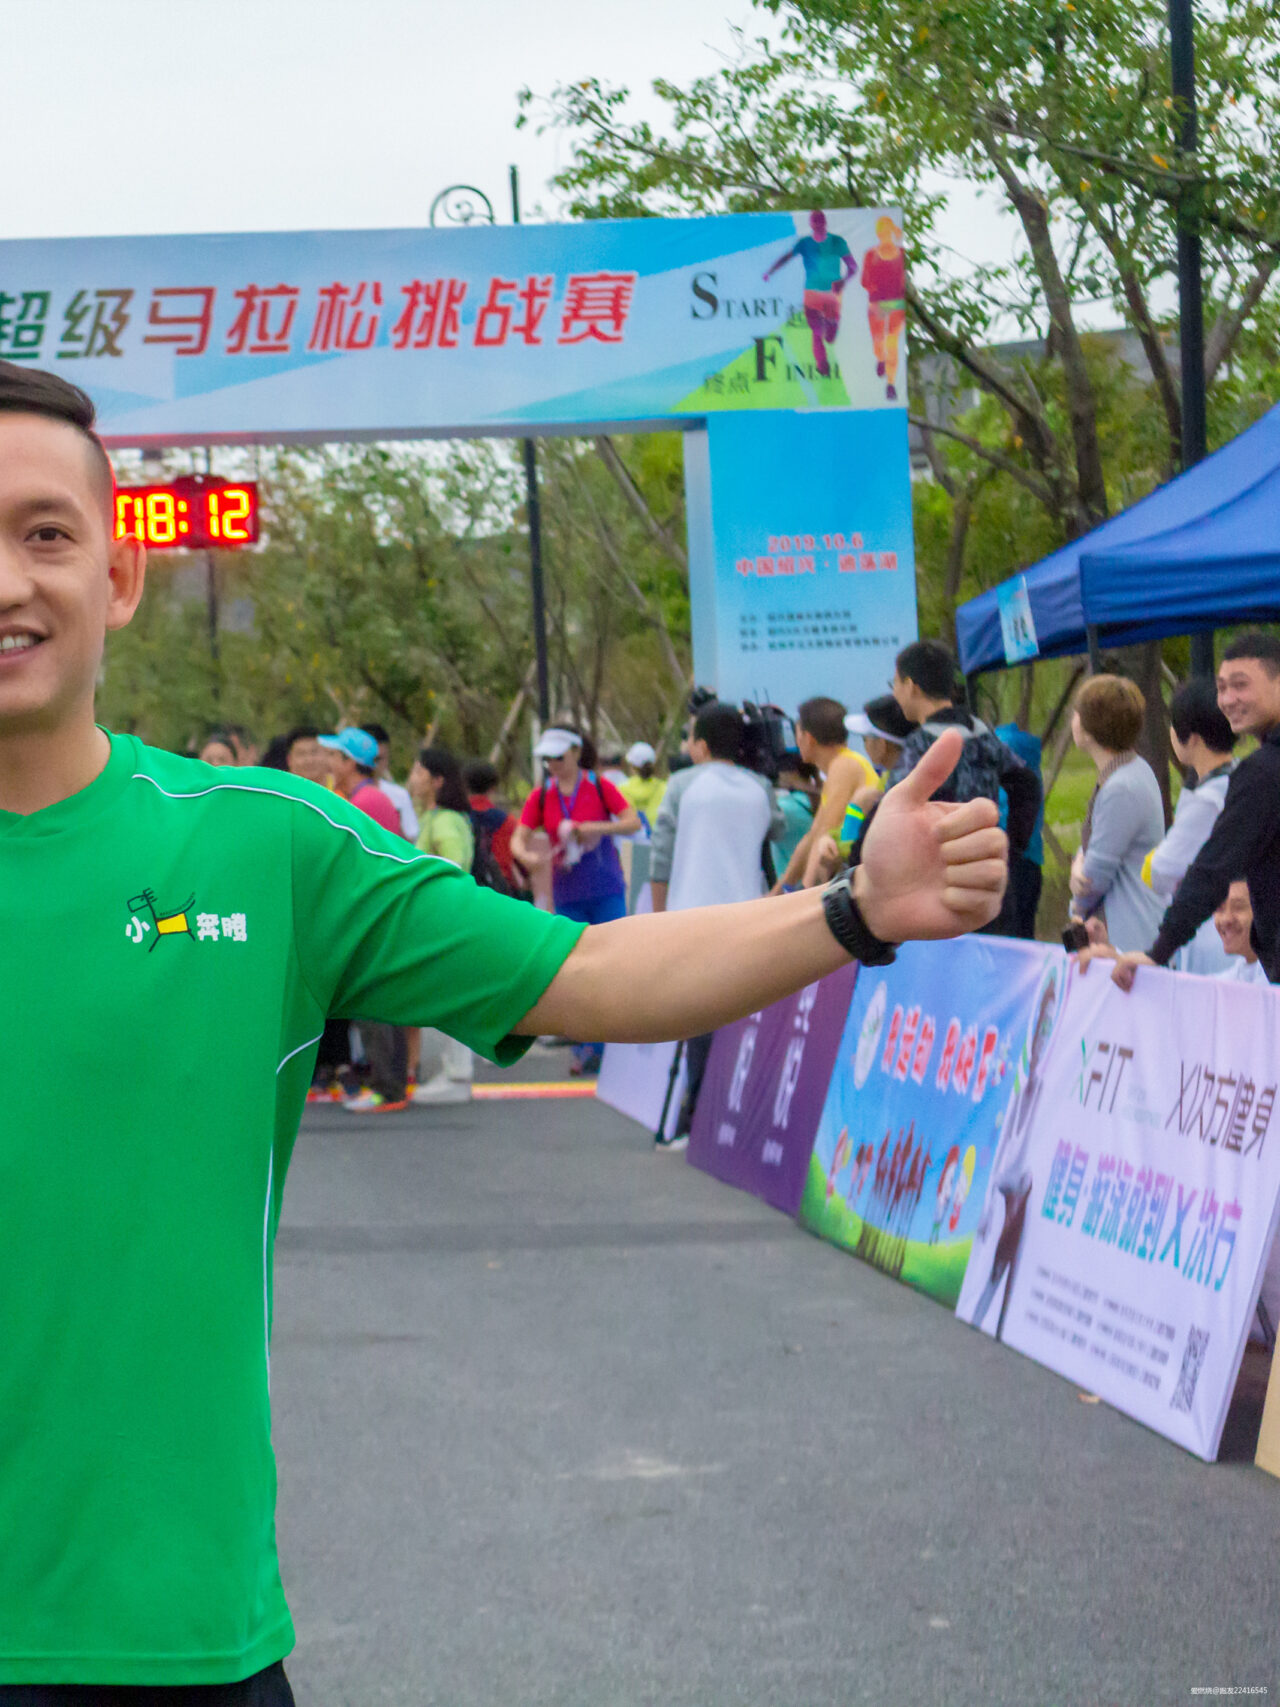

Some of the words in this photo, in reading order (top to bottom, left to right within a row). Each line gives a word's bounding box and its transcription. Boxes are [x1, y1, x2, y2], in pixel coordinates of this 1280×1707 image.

[691, 272, 782, 320] START
[125, 916, 151, 943] 小
[1069, 1037, 1135, 1114] XFIT
